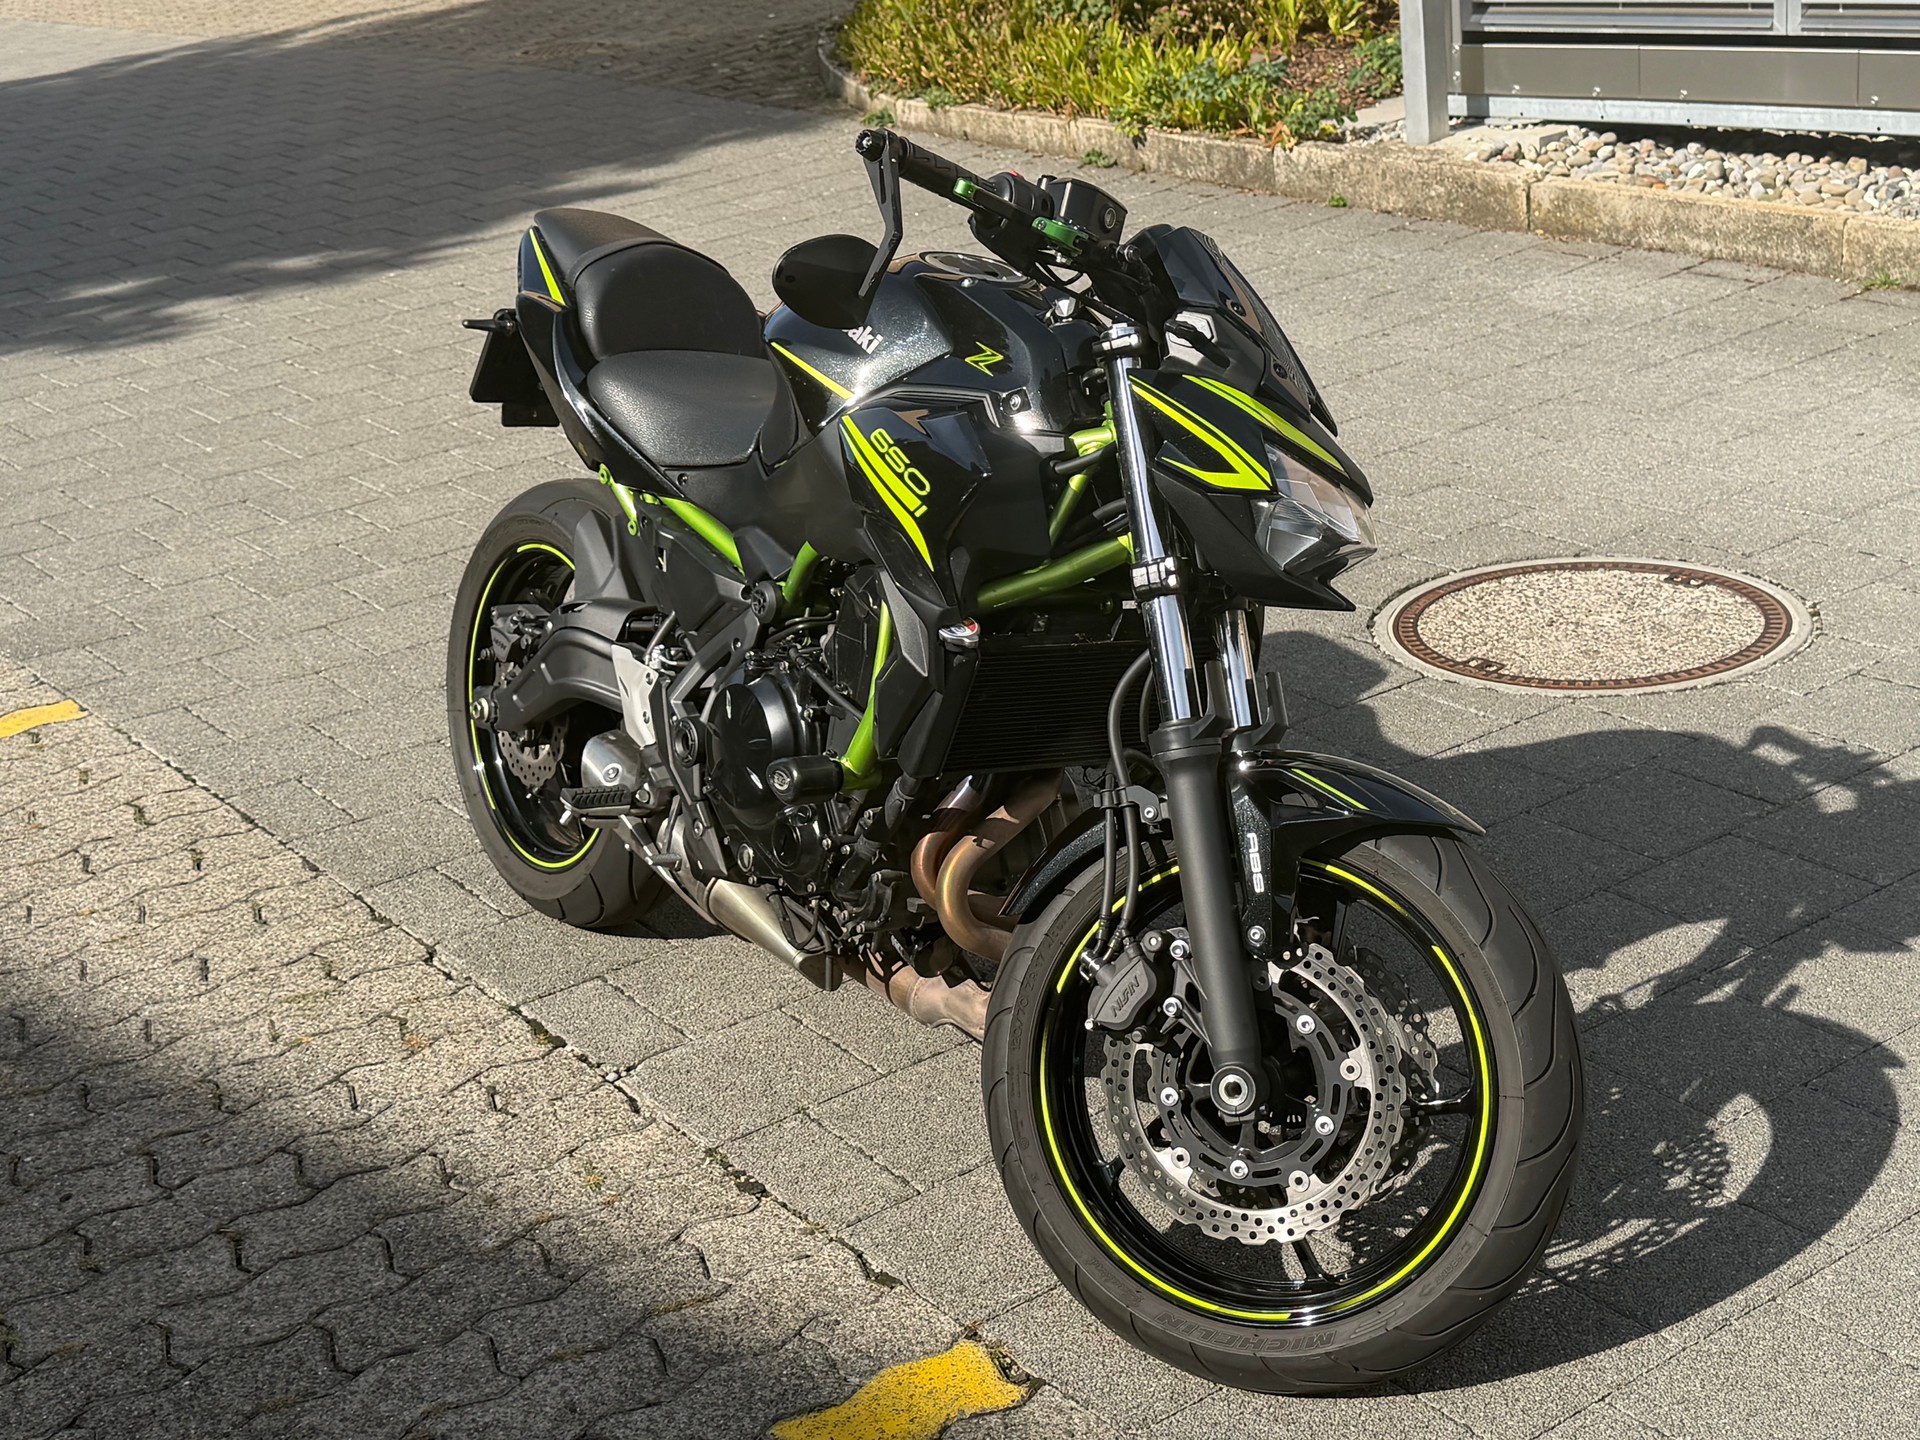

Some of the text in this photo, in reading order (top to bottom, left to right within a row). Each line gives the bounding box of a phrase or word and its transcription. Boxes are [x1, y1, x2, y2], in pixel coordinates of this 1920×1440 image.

[870, 428, 931, 496] 650
[1247, 833, 1265, 893] ABS
[1156, 1309, 1337, 1351] MICHELIN
